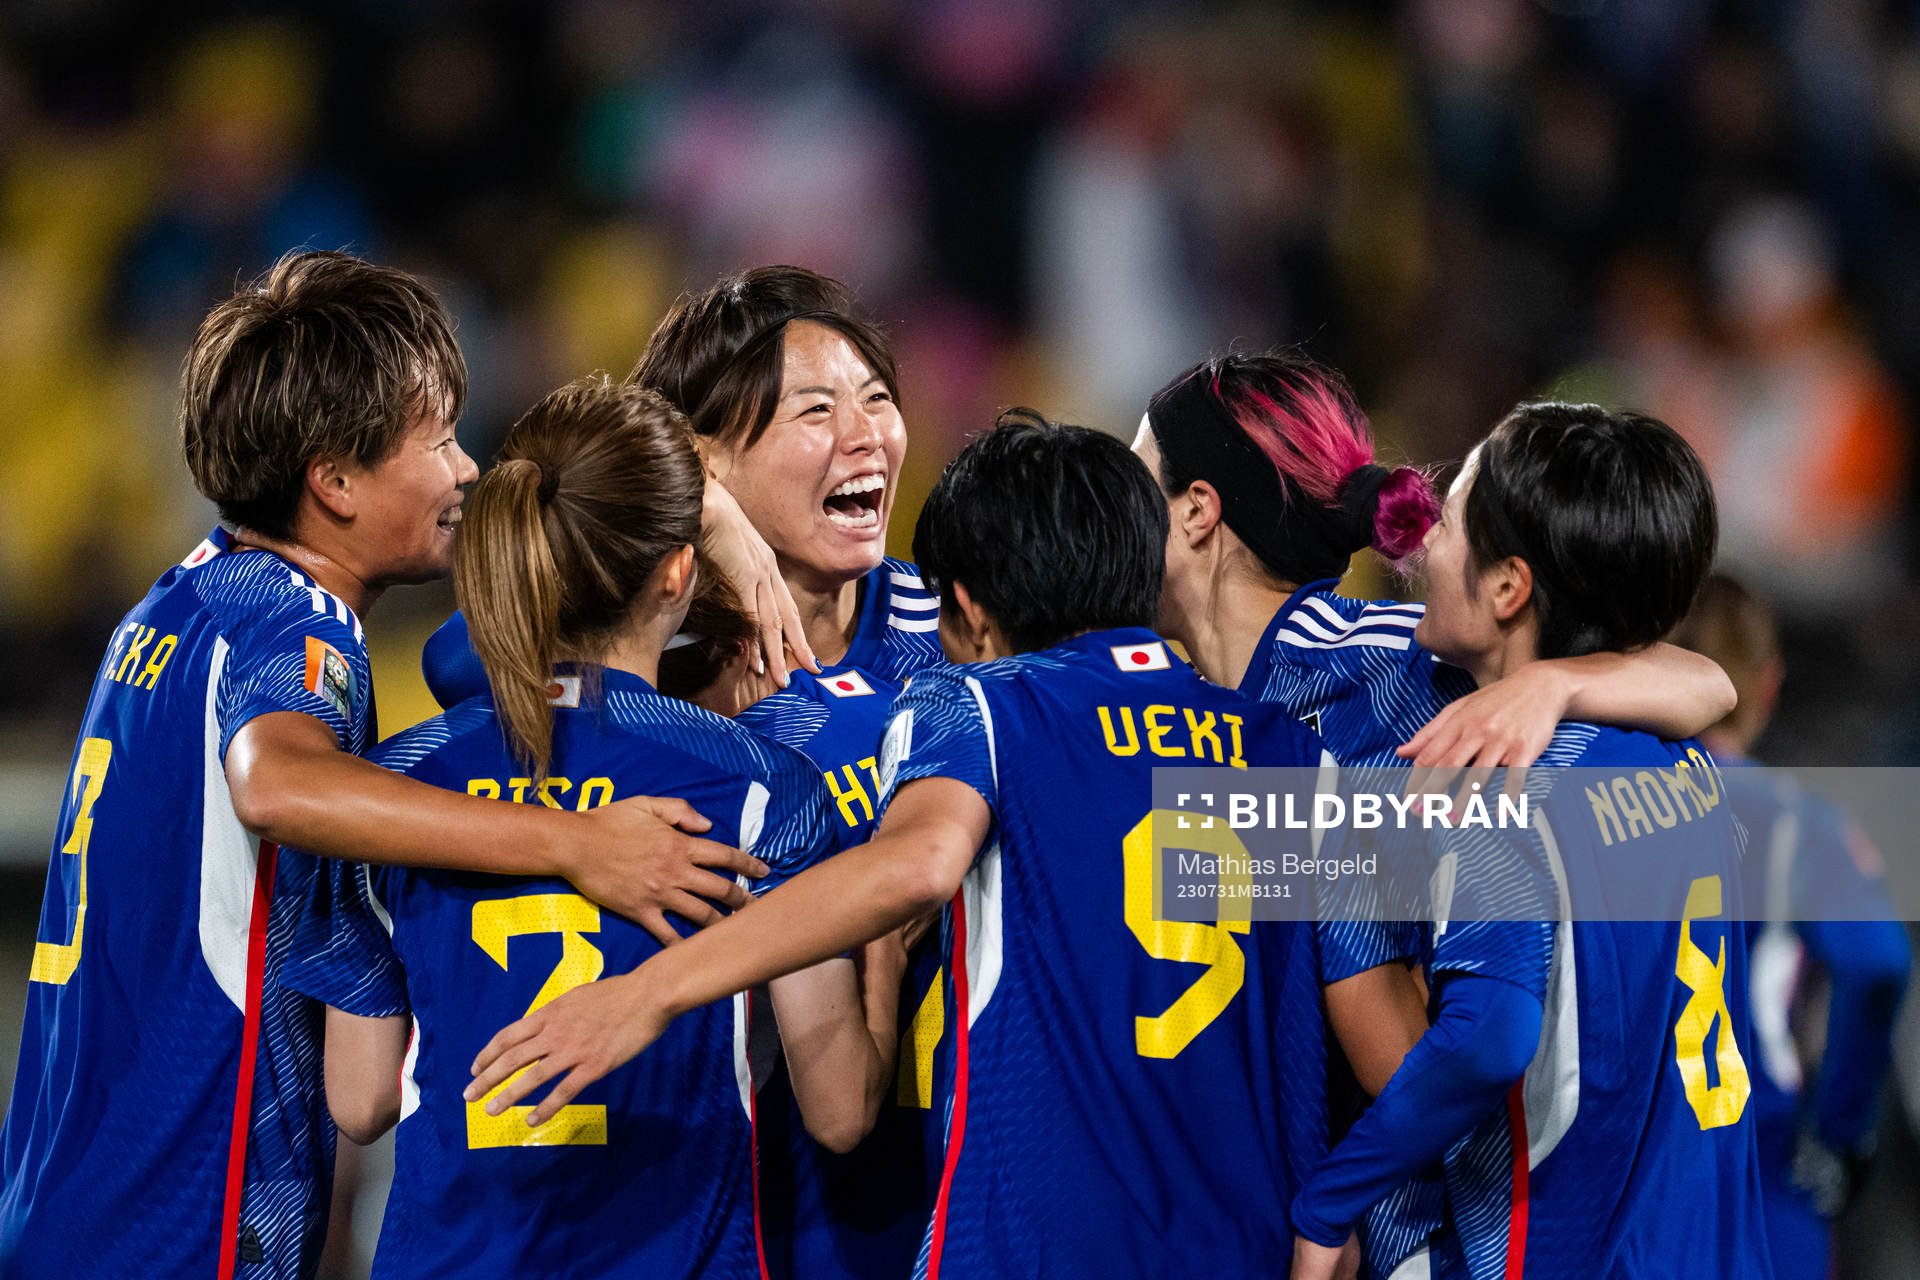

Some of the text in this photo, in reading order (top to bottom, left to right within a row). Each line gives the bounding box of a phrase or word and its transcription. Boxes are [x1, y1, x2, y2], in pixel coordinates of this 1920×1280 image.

[30, 738, 112, 985] 3
[1097, 704, 1248, 771] UEKI
[466, 894, 607, 1149] 2
[1122, 809, 1253, 1060] 9
